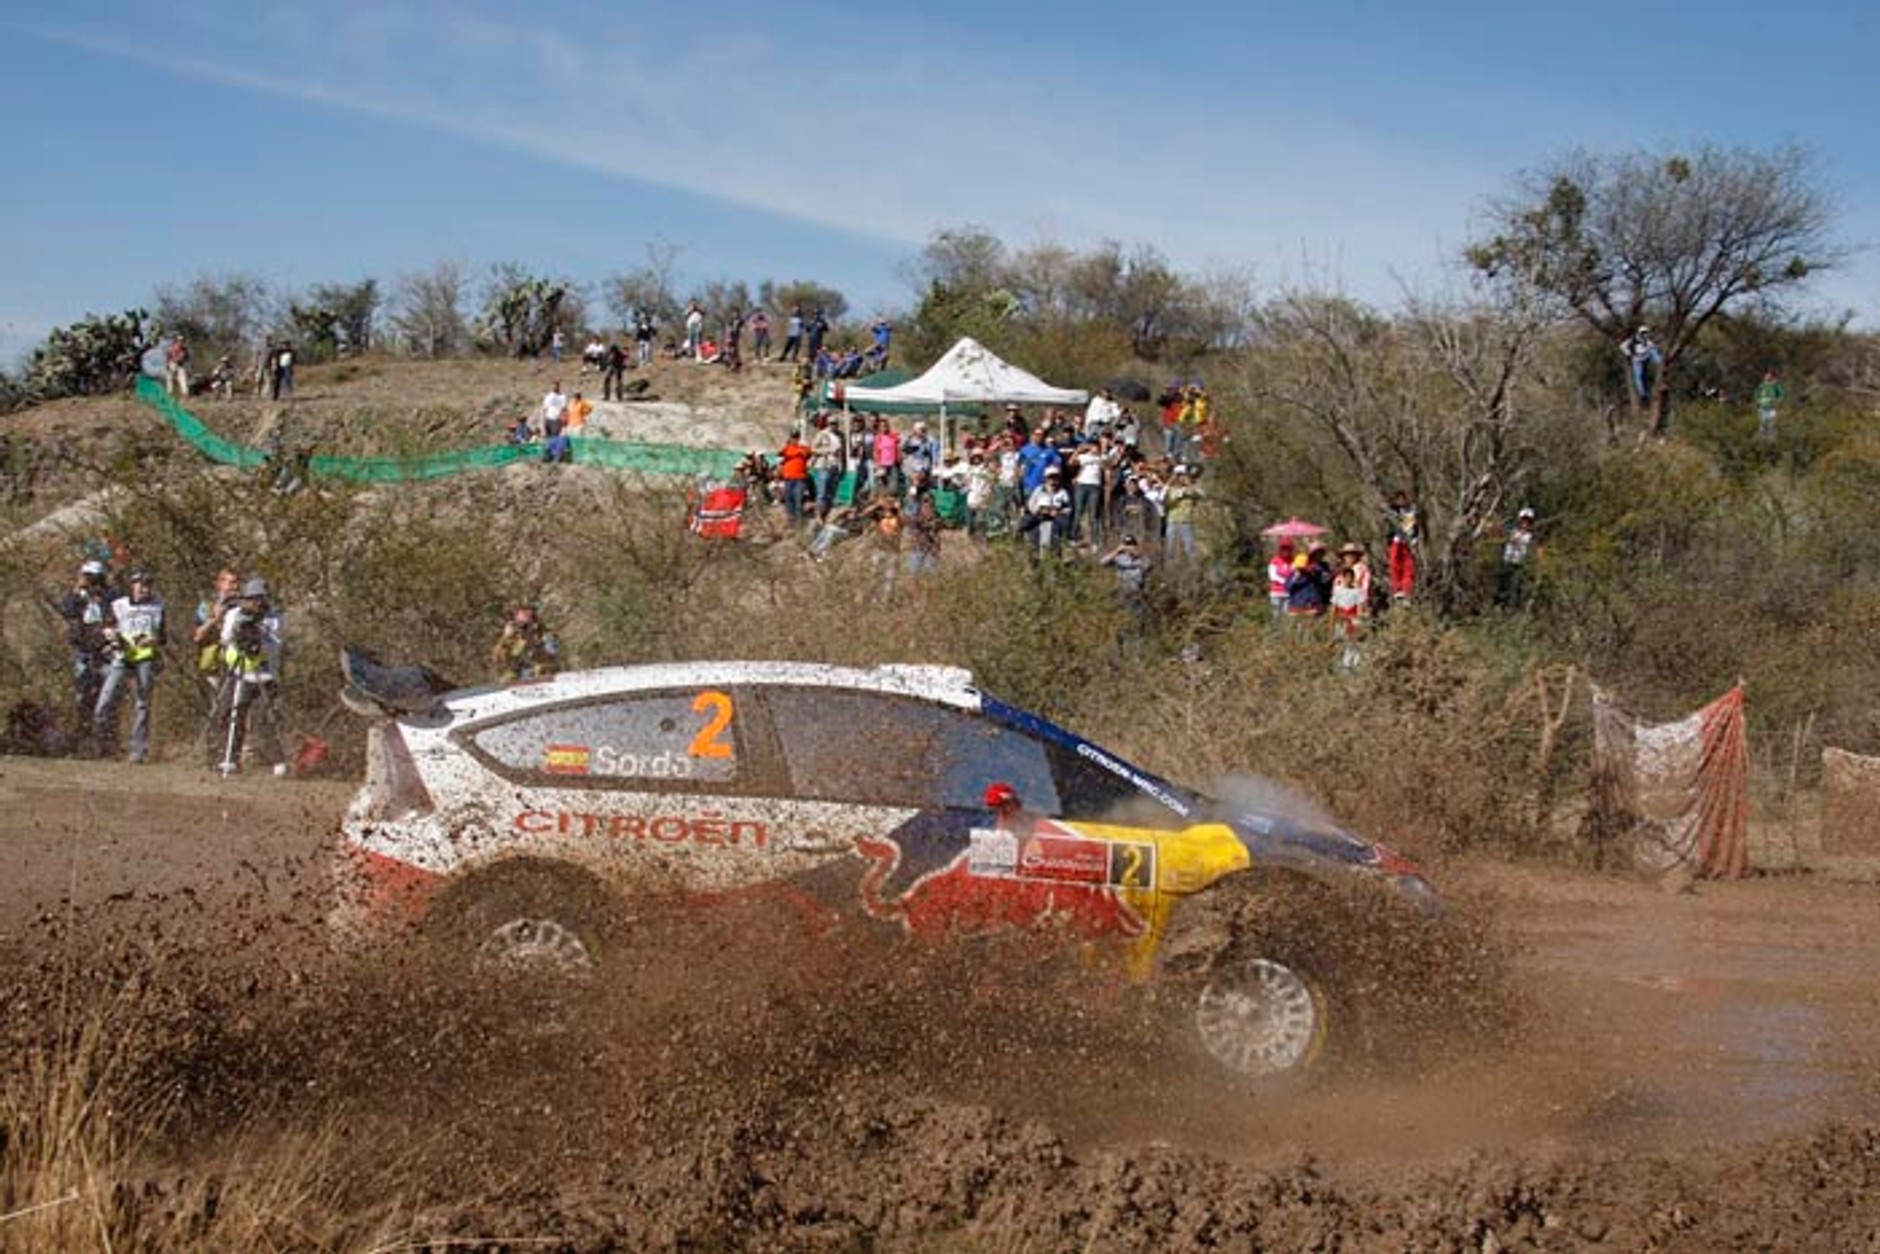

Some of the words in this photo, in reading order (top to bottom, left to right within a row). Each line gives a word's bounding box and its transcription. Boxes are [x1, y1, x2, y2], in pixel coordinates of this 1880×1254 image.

[688, 689, 734, 759] 2
[596, 745, 691, 777] Sordo
[1120, 844, 1143, 887] 2
